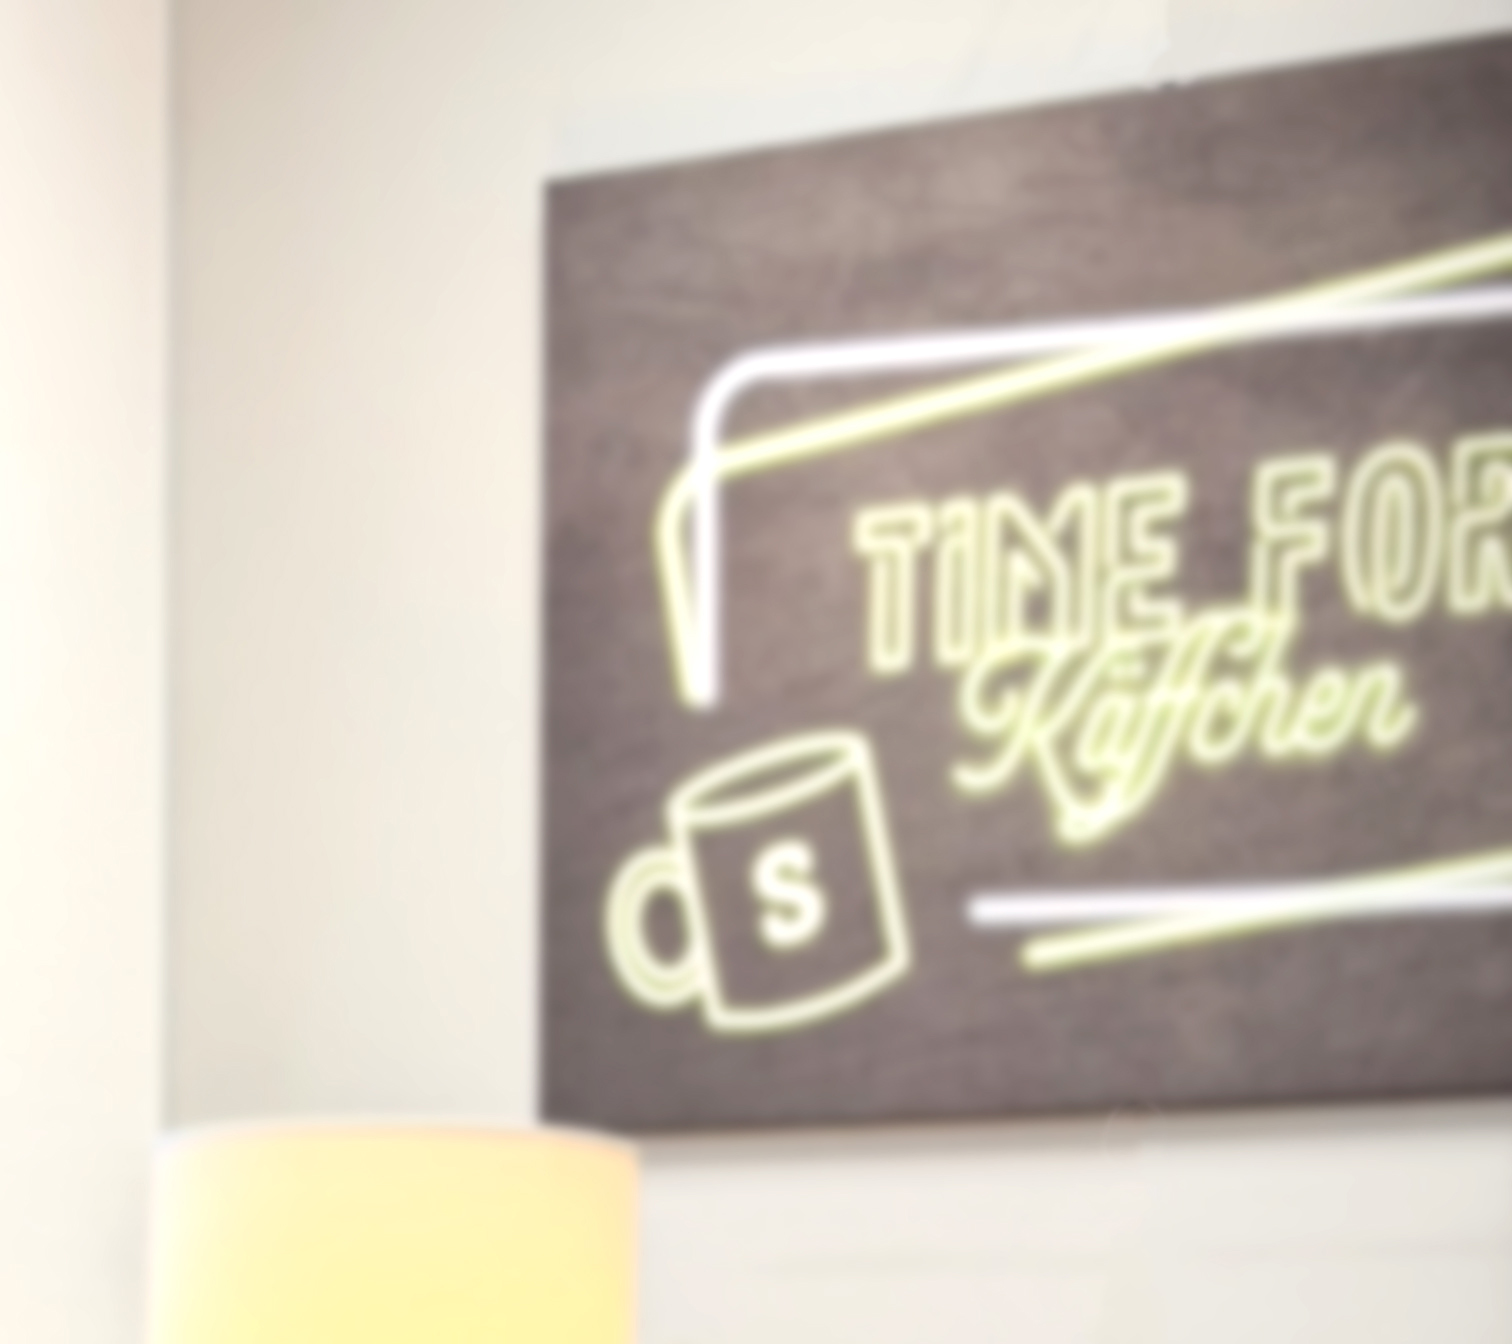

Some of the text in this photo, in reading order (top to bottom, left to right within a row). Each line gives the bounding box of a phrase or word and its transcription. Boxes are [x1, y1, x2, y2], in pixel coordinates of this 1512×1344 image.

[853, 432, 1512, 674] TIME FOR
[952, 606, 1419, 845] Käffchen
[751, 841, 826, 948] S
